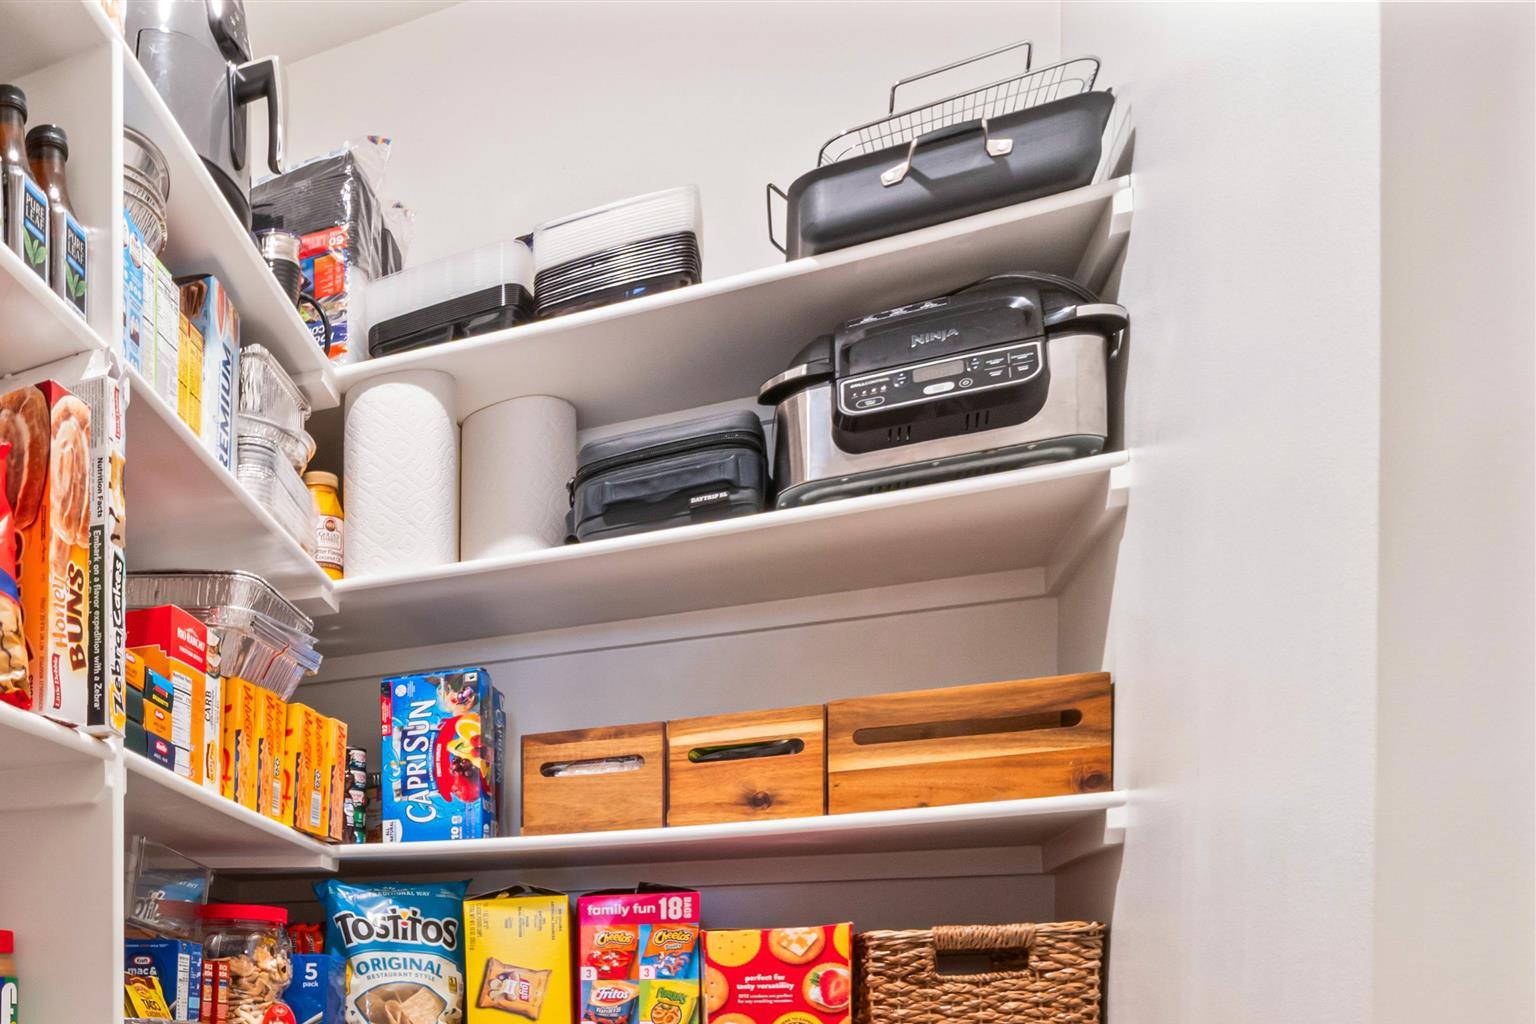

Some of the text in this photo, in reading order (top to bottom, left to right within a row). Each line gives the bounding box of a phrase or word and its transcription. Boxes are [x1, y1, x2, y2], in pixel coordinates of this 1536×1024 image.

[25, 191, 45, 217] PURE
[25, 207, 45, 232] LEAF
[67, 228, 85, 250] PURE
[911, 328, 959, 348] NINJA
[93, 530, 101, 562] Embark
[93, 584, 101, 608] flavor
[66, 562, 86, 672] BUNS
[92, 610, 100, 654] expedition
[111, 557, 125, 716] Zebra Cakes
[92, 656, 100, 674] with
[205, 691, 213, 722] CARB
[587, 897, 682, 920] family fun 18
[683, 897, 692, 919] BAGS
[596, 929, 692, 946] Cheetos Cheetos
[305, 963, 318, 980] 5
[356, 956, 444, 980] ORIGINAL
[367, 972, 436, 983] RESTAURANT STYLE
[585, 968, 650, 979] 3 3
[744, 973, 786, 983] perfect for
[302, 980, 319, 988] pack
[595, 987, 632, 1001] Fritos
[736, 981, 795, 991] tasty versatility
